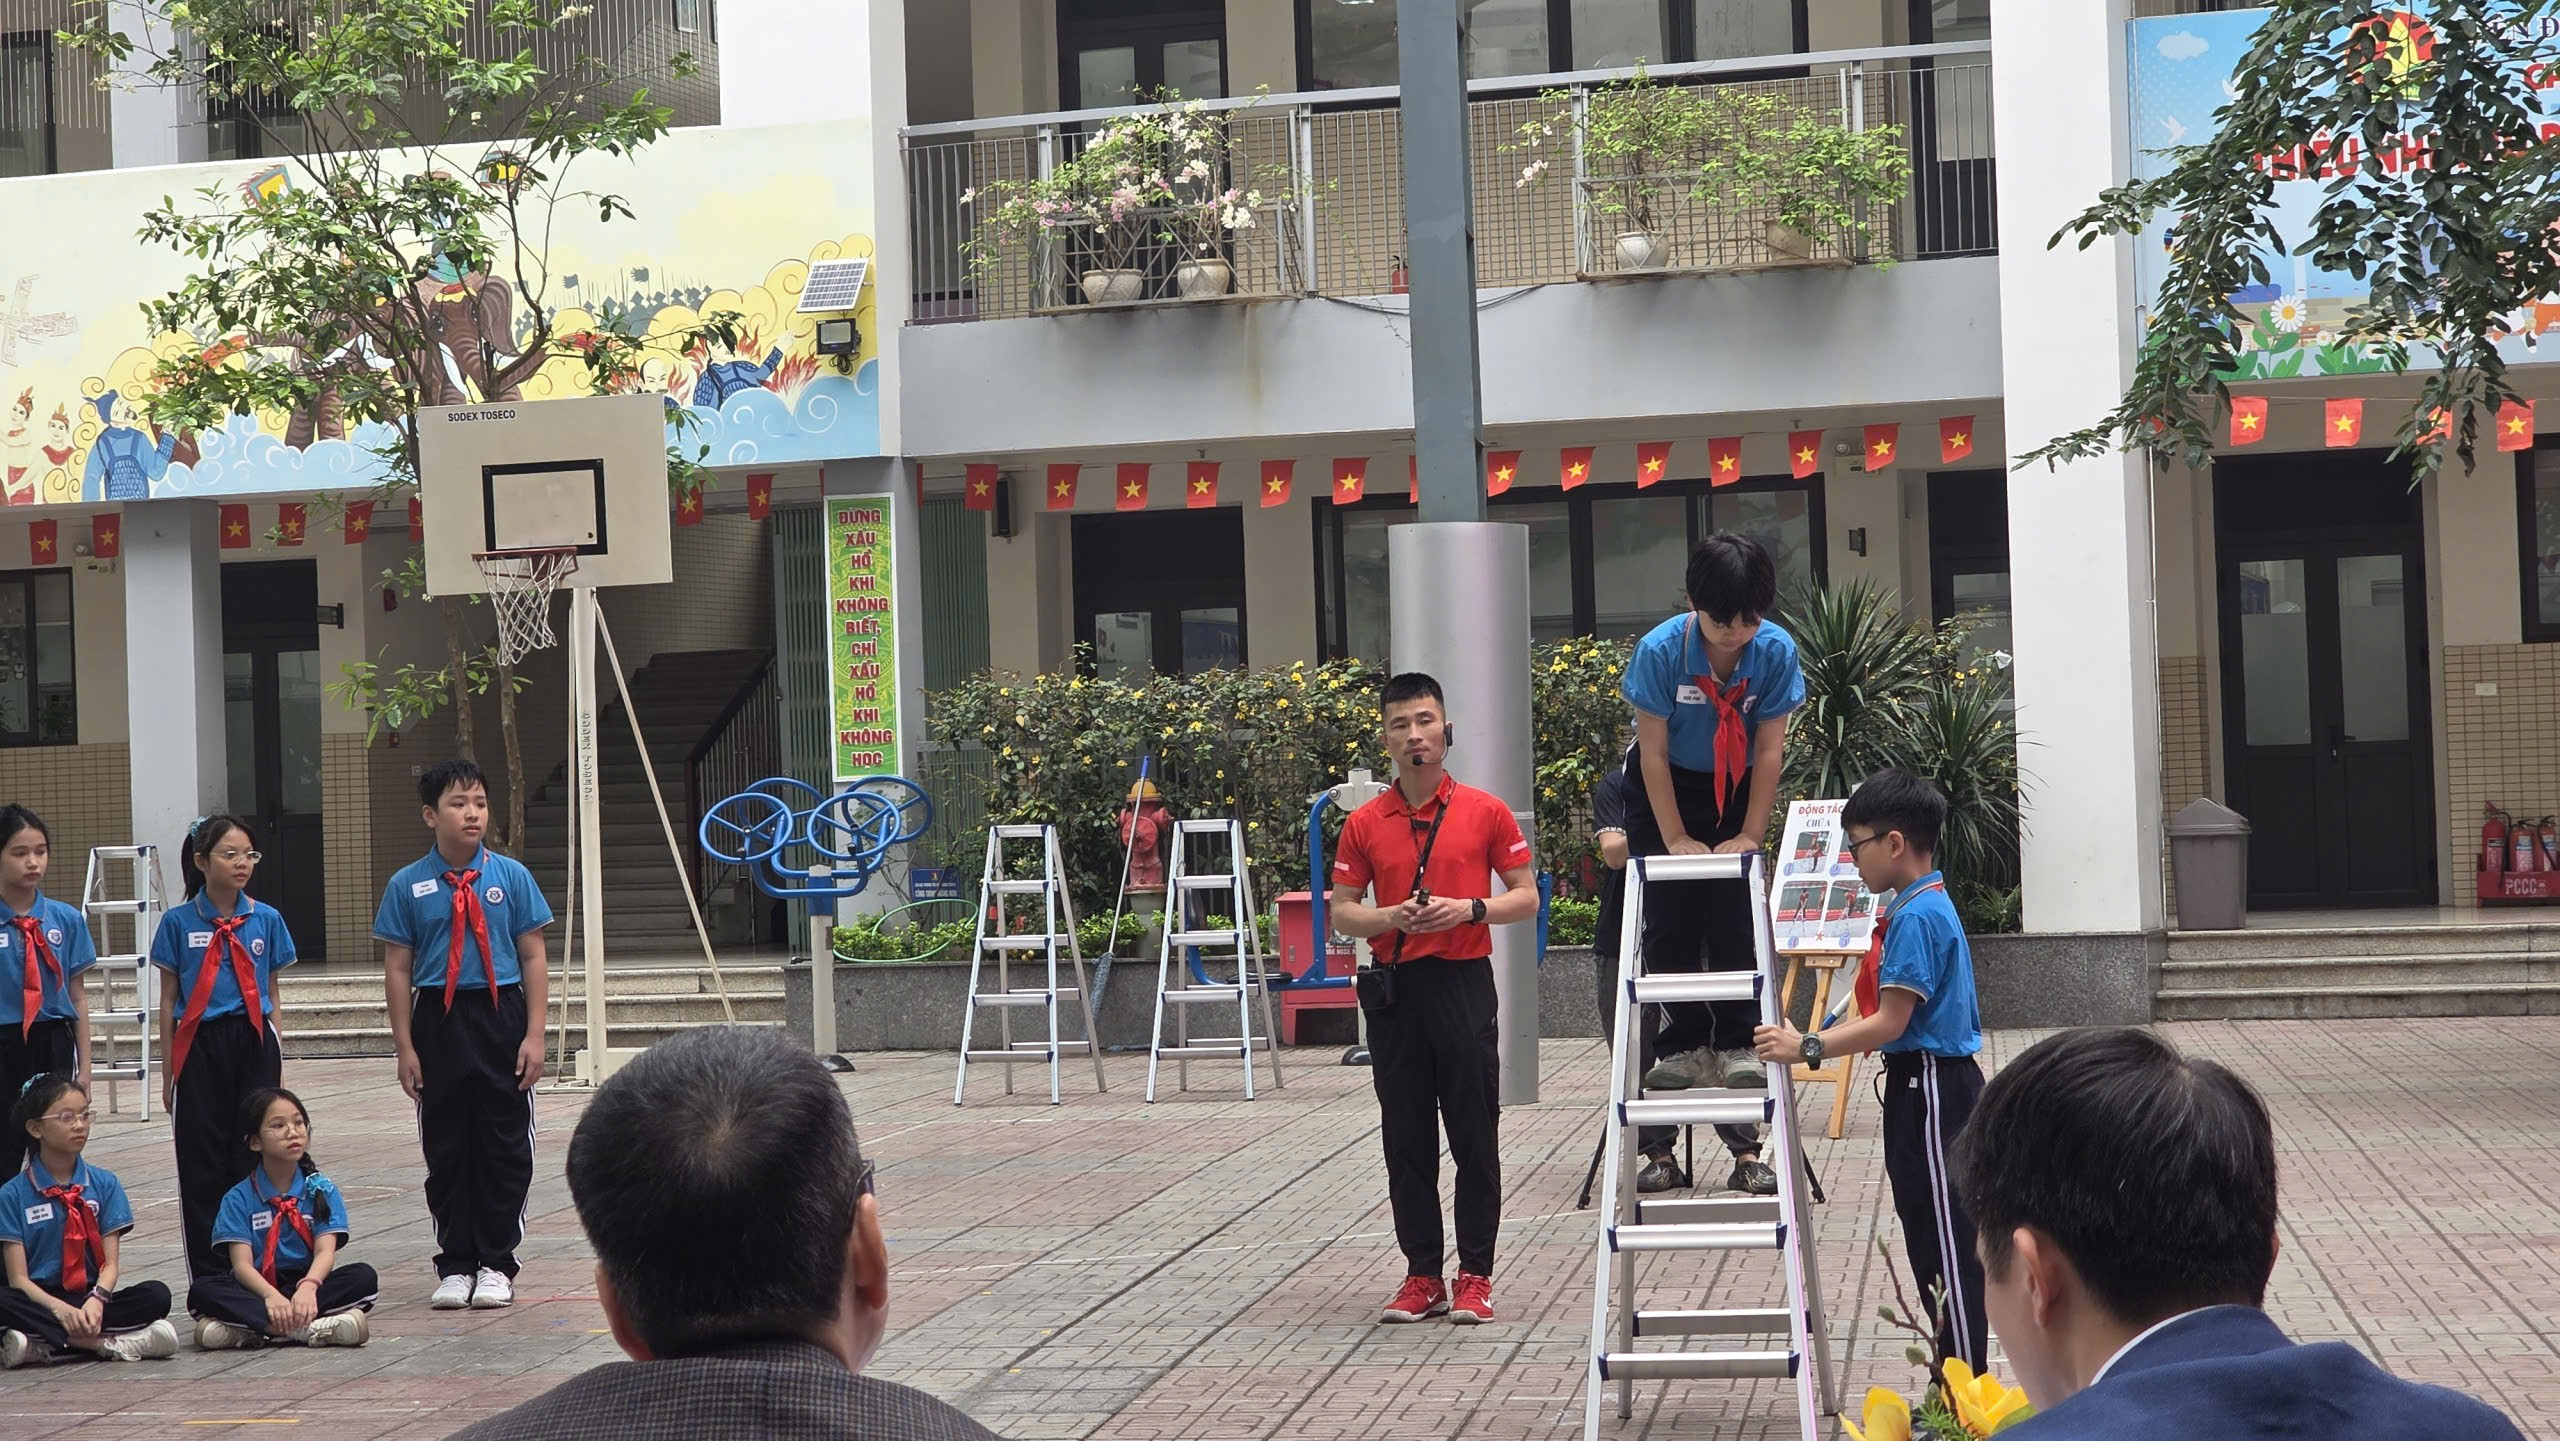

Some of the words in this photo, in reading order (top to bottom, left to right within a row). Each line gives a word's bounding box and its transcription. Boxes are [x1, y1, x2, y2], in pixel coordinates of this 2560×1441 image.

[448, 412, 478, 422] SODEX
[480, 409, 516, 420] TOSECO
[845, 528, 876, 546] XẤU
[851, 549, 872, 568] HỔ
[849, 576, 875, 590] KHI
[836, 596, 889, 612] KHÔNG
[845, 615, 880, 636] BIẾT,
[851, 637, 877, 656] CHỈ
[849, 659, 880, 679] XẤU
[855, 681, 876, 699] HỔ
[853, 708, 879, 722] KHI
[840, 728, 893, 745] KHÔNG
[852, 751, 882, 768] HỌC
[1798, 803, 1825, 816] ĐỘNG
[2505, 878, 2537, 895] PCCC
